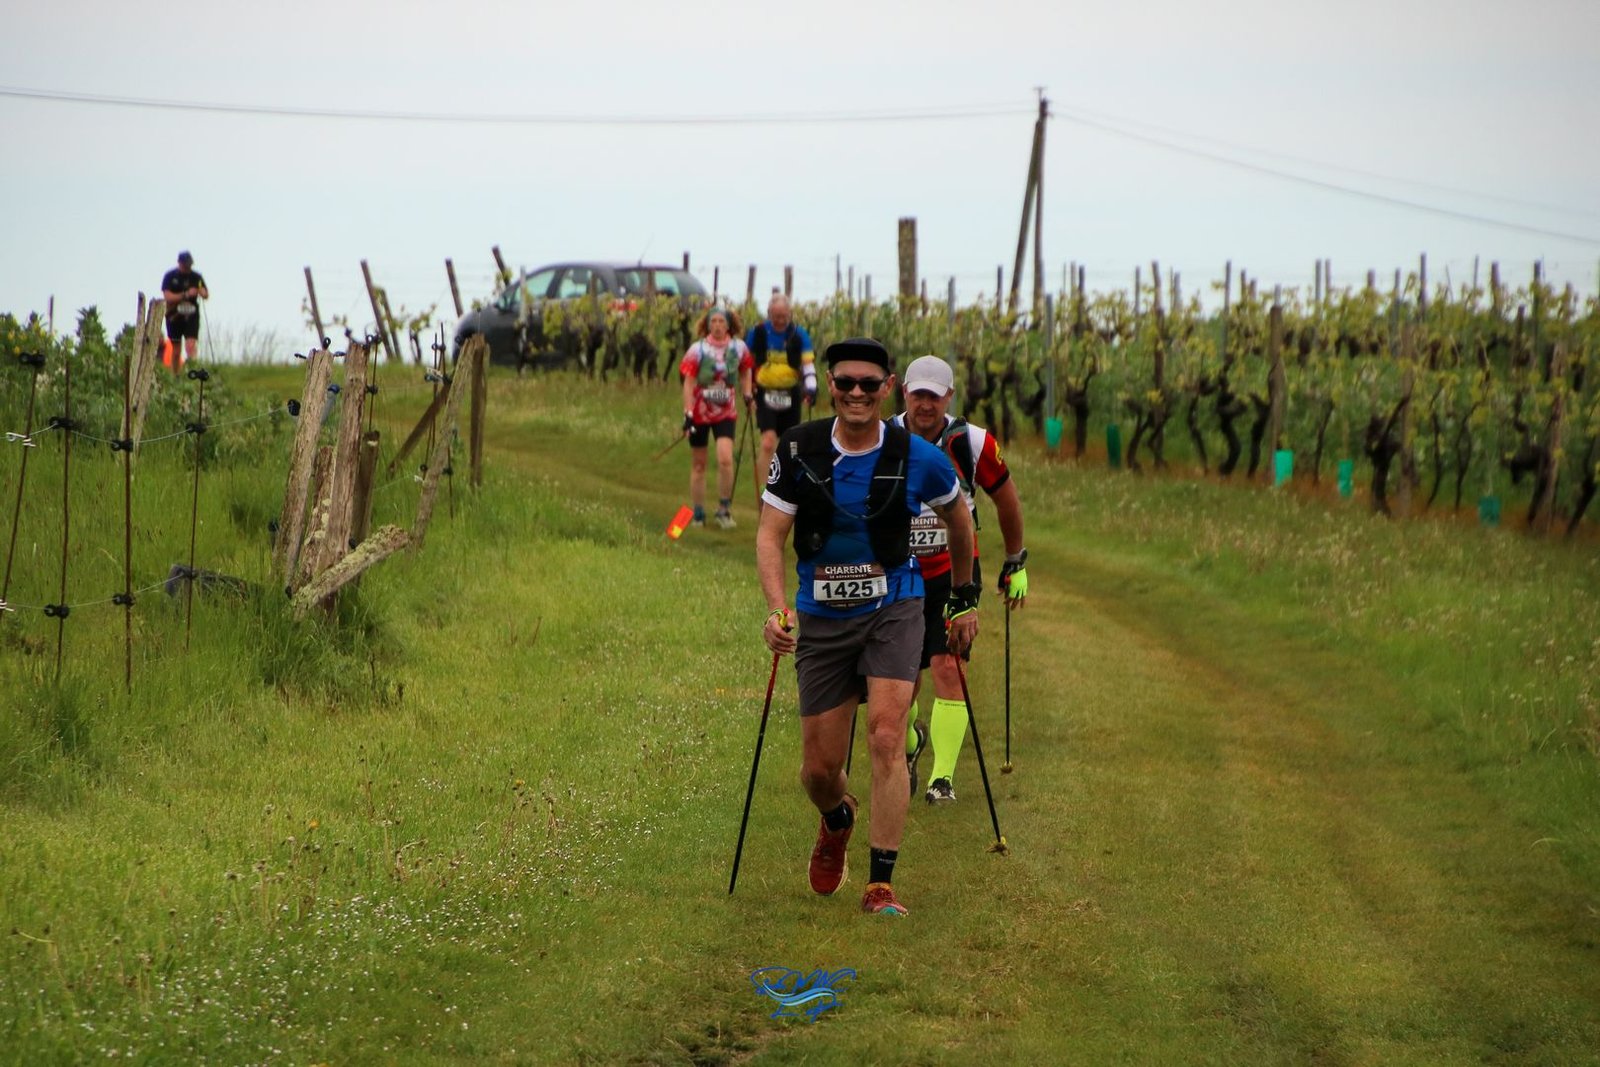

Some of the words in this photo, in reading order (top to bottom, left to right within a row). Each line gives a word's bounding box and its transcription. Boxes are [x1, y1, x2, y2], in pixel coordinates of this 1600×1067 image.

[910, 517, 938, 525] ARENTE
[909, 531, 938, 545] 427
[825, 564, 873, 575] CHARENTE
[822, 580, 874, 599] 1425
